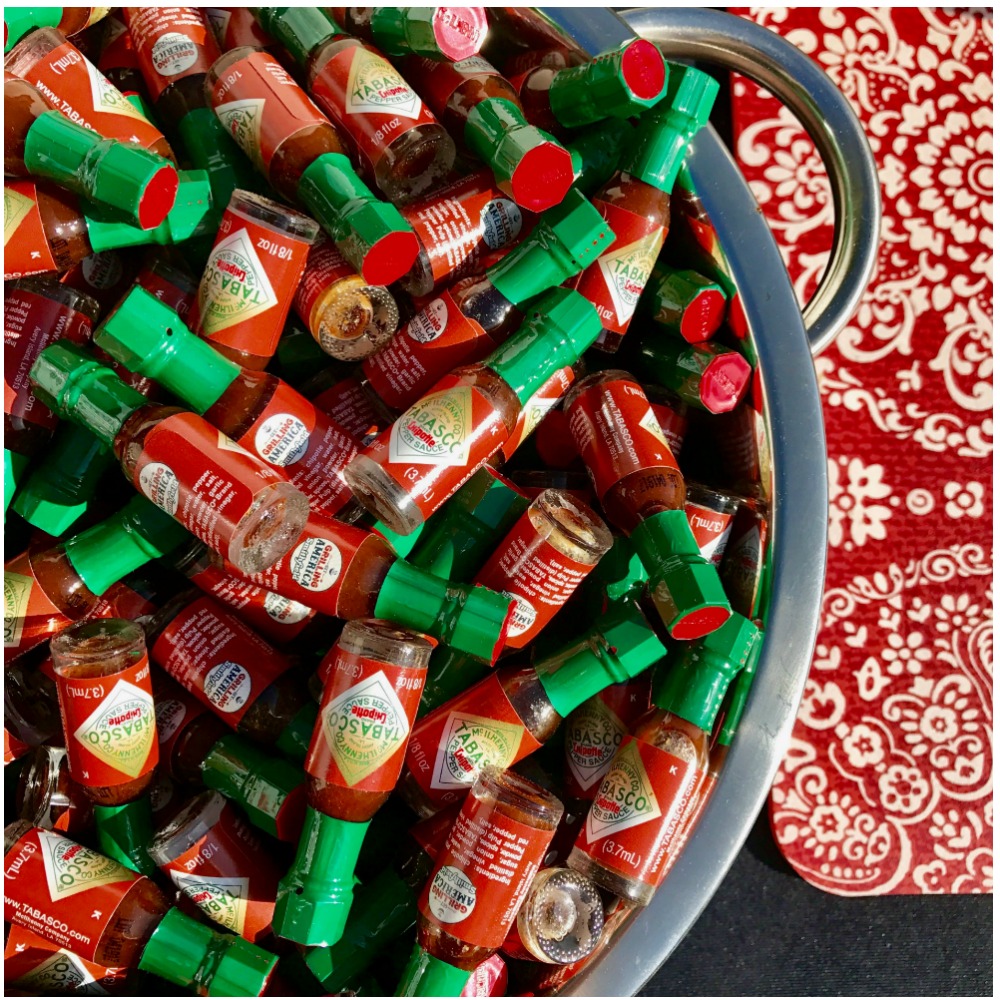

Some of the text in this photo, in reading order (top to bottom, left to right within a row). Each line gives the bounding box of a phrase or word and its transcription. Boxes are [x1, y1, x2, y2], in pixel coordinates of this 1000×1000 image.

[371, 130, 384, 146] 1/8
[390, 118, 402, 129] oz
[30, 251, 41, 259] K
[257, 238, 270, 250] oz
[277, 246, 293, 260] 1/8
[602, 309, 614, 319] oz
[262, 418, 294, 456] GRILLING
[605, 390, 639, 464] www.TABASCO.com
[268, 421, 303, 463] AMERICA
[192, 470, 213, 492] pepper,
[208, 480, 224, 497] garlic
[215, 482, 233, 500] Brand
[301, 539, 325, 587] AMERICA
[310, 544, 332, 588] GRILLING
[66, 684, 104, 699] (3.7mL)
[210, 665, 242, 704] AMERICA
[218, 674, 246, 708] GRILLING
[88, 713, 154, 744] TABASCO
[329, 712, 398, 741] TABASCO
[410, 737, 421, 753] 1/8
[418, 759, 430, 773] oz
[82, 771, 89, 779] K
[669, 765, 678, 776] K
[602, 806, 630, 820] SAUCE
[650, 775, 698, 873] www.TABASCO.com
[492, 824, 516, 840] pepper,
[202, 843, 219, 858] 1/8
[476, 847, 494, 859] onion
[488, 833, 525, 854] Pepper Pulp
[602, 839, 641, 868] (3.7mL)
[4, 842, 37, 880] (3.7mL)
[184, 861, 196, 870] oz
[489, 863, 515, 876] distilled
[474, 864, 511, 886] Ingredients:
[432, 885, 467, 914] GRILLING
[435, 874, 475, 906] AMERICA
[91, 910, 102, 920] K
[16, 911, 70, 942] McIlhenny Company
[15, 943, 25, 951] K
